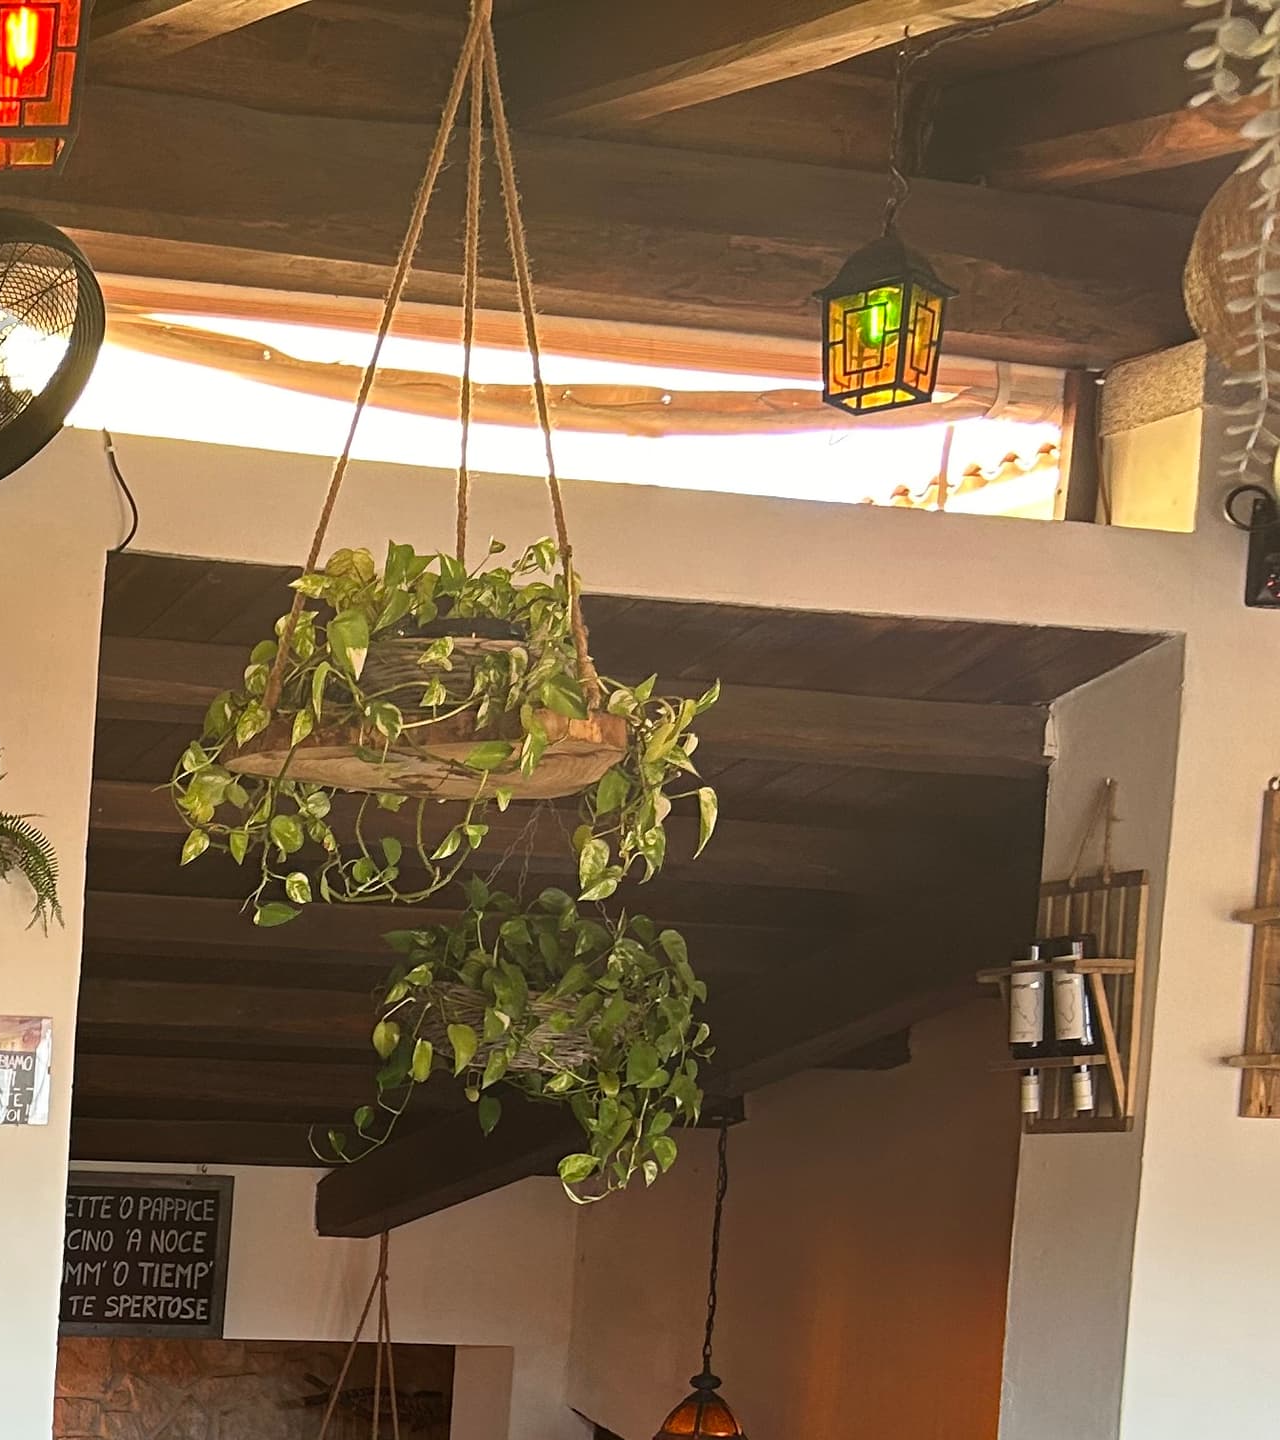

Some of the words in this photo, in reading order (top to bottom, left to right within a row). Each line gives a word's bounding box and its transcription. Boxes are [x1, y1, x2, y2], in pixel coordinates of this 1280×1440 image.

[138, 1196, 215, 1222] PAPPICE
[150, 1229, 207, 1253] NOCE
[68, 1296, 97, 1316] TE
[104, 1295, 209, 1321] SPERTOSE
